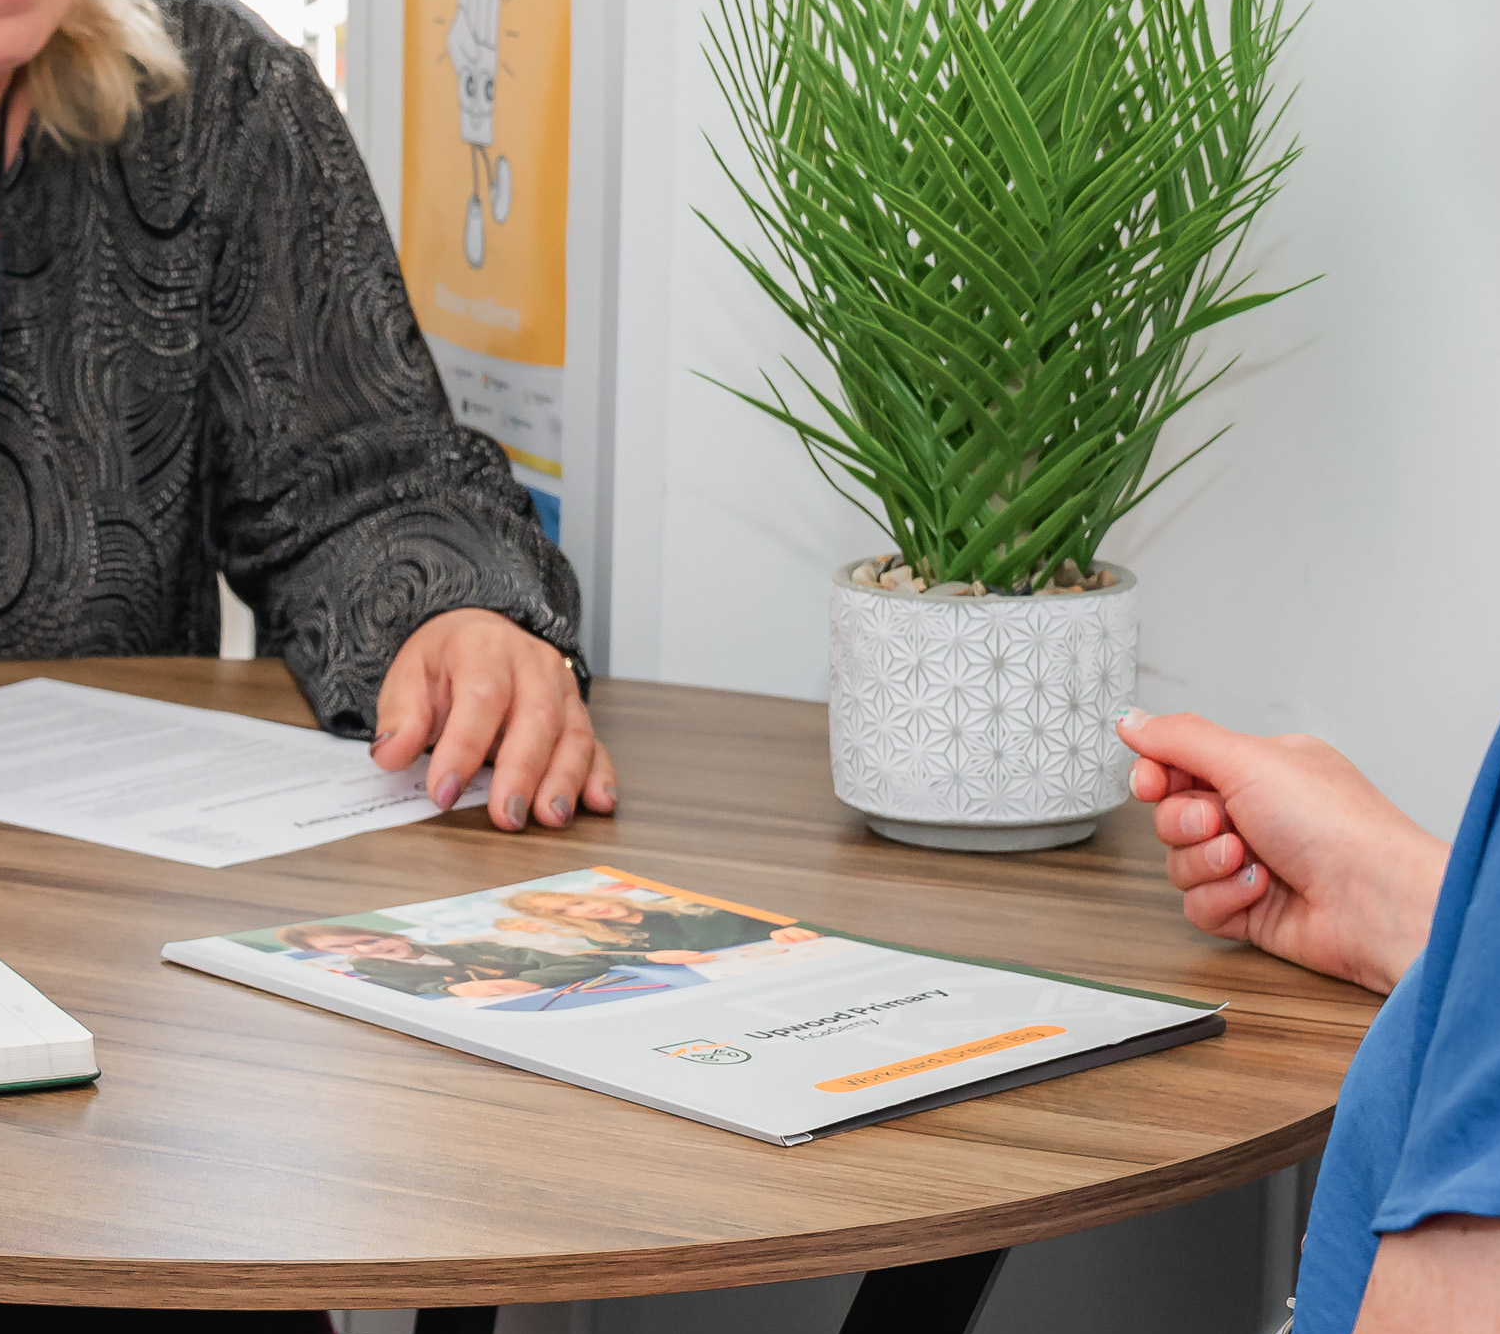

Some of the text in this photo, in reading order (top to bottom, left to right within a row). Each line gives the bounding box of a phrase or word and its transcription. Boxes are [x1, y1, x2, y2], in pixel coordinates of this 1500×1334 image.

[744, 988, 950, 1041] Upwood Primary
[795, 1017, 880, 1042] Academy
[839, 1070, 892, 1087] Work
[943, 1040, 1010, 1058] Dream
